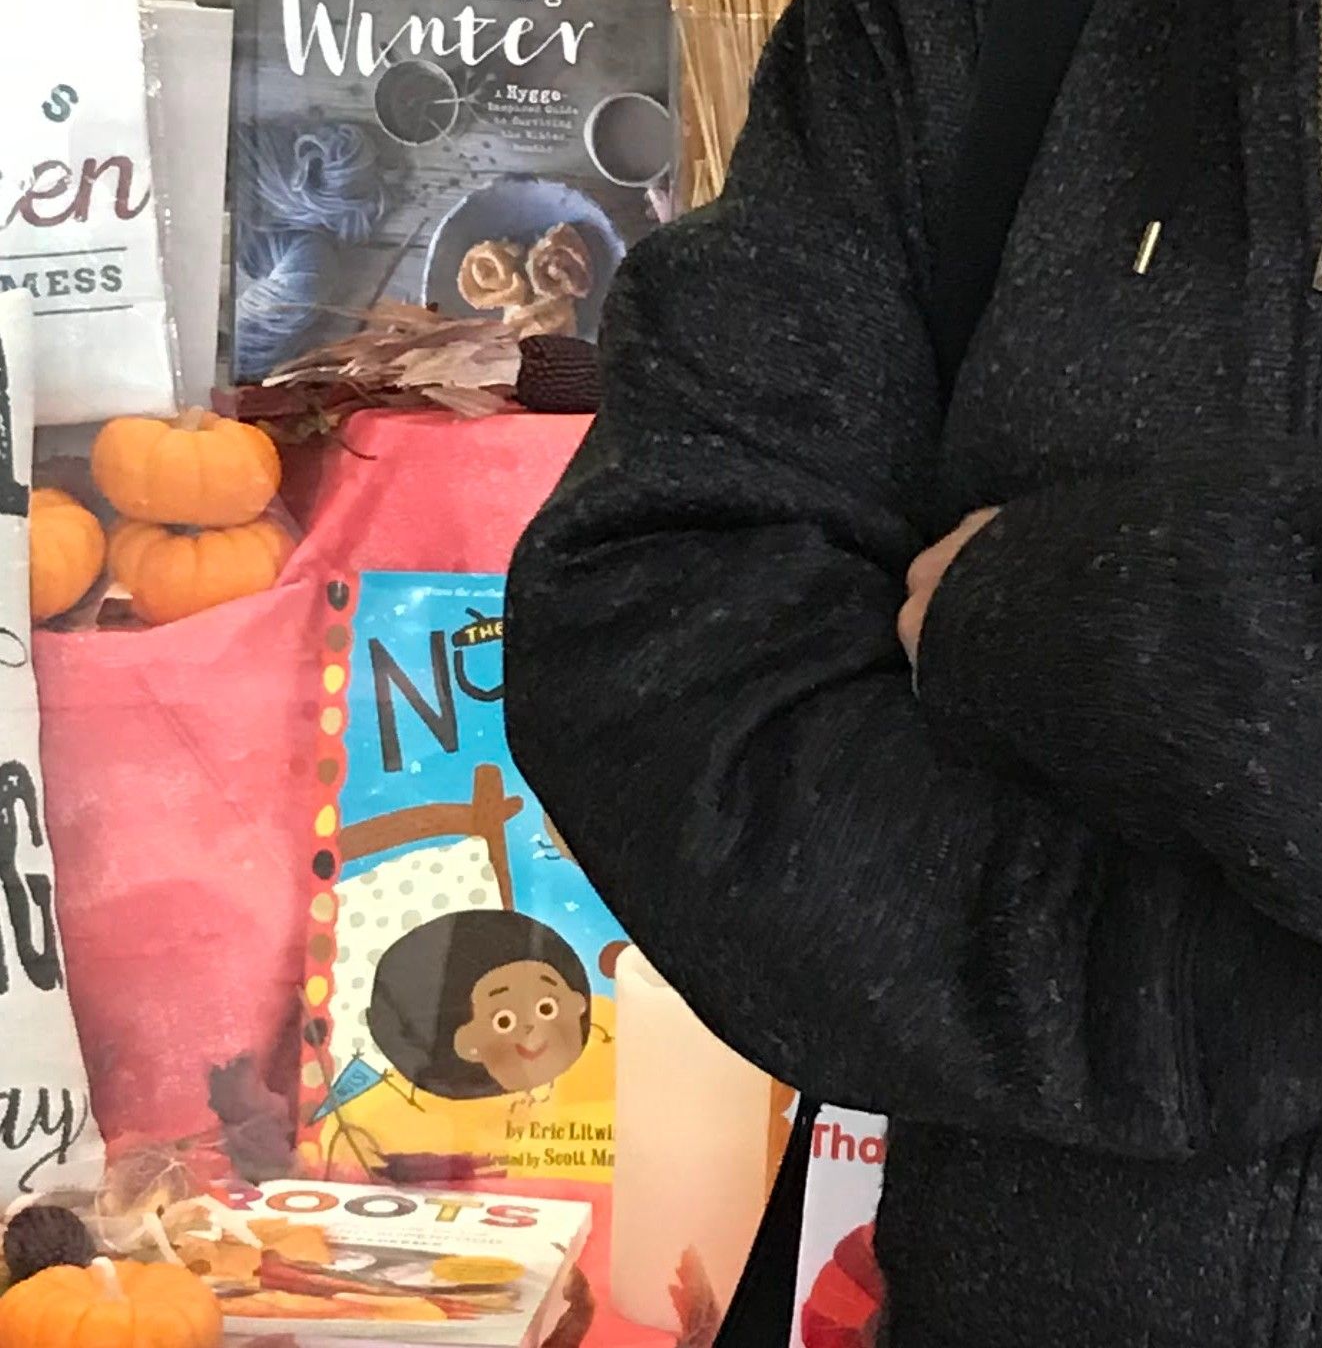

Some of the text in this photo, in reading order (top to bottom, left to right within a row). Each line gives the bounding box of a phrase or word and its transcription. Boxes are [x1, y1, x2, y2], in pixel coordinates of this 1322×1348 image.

[505, 1120, 614, 1142] by Eric Litwi
[544, 1148, 586, 1167] Scott
[206, 1185, 540, 1228] ROOTS
